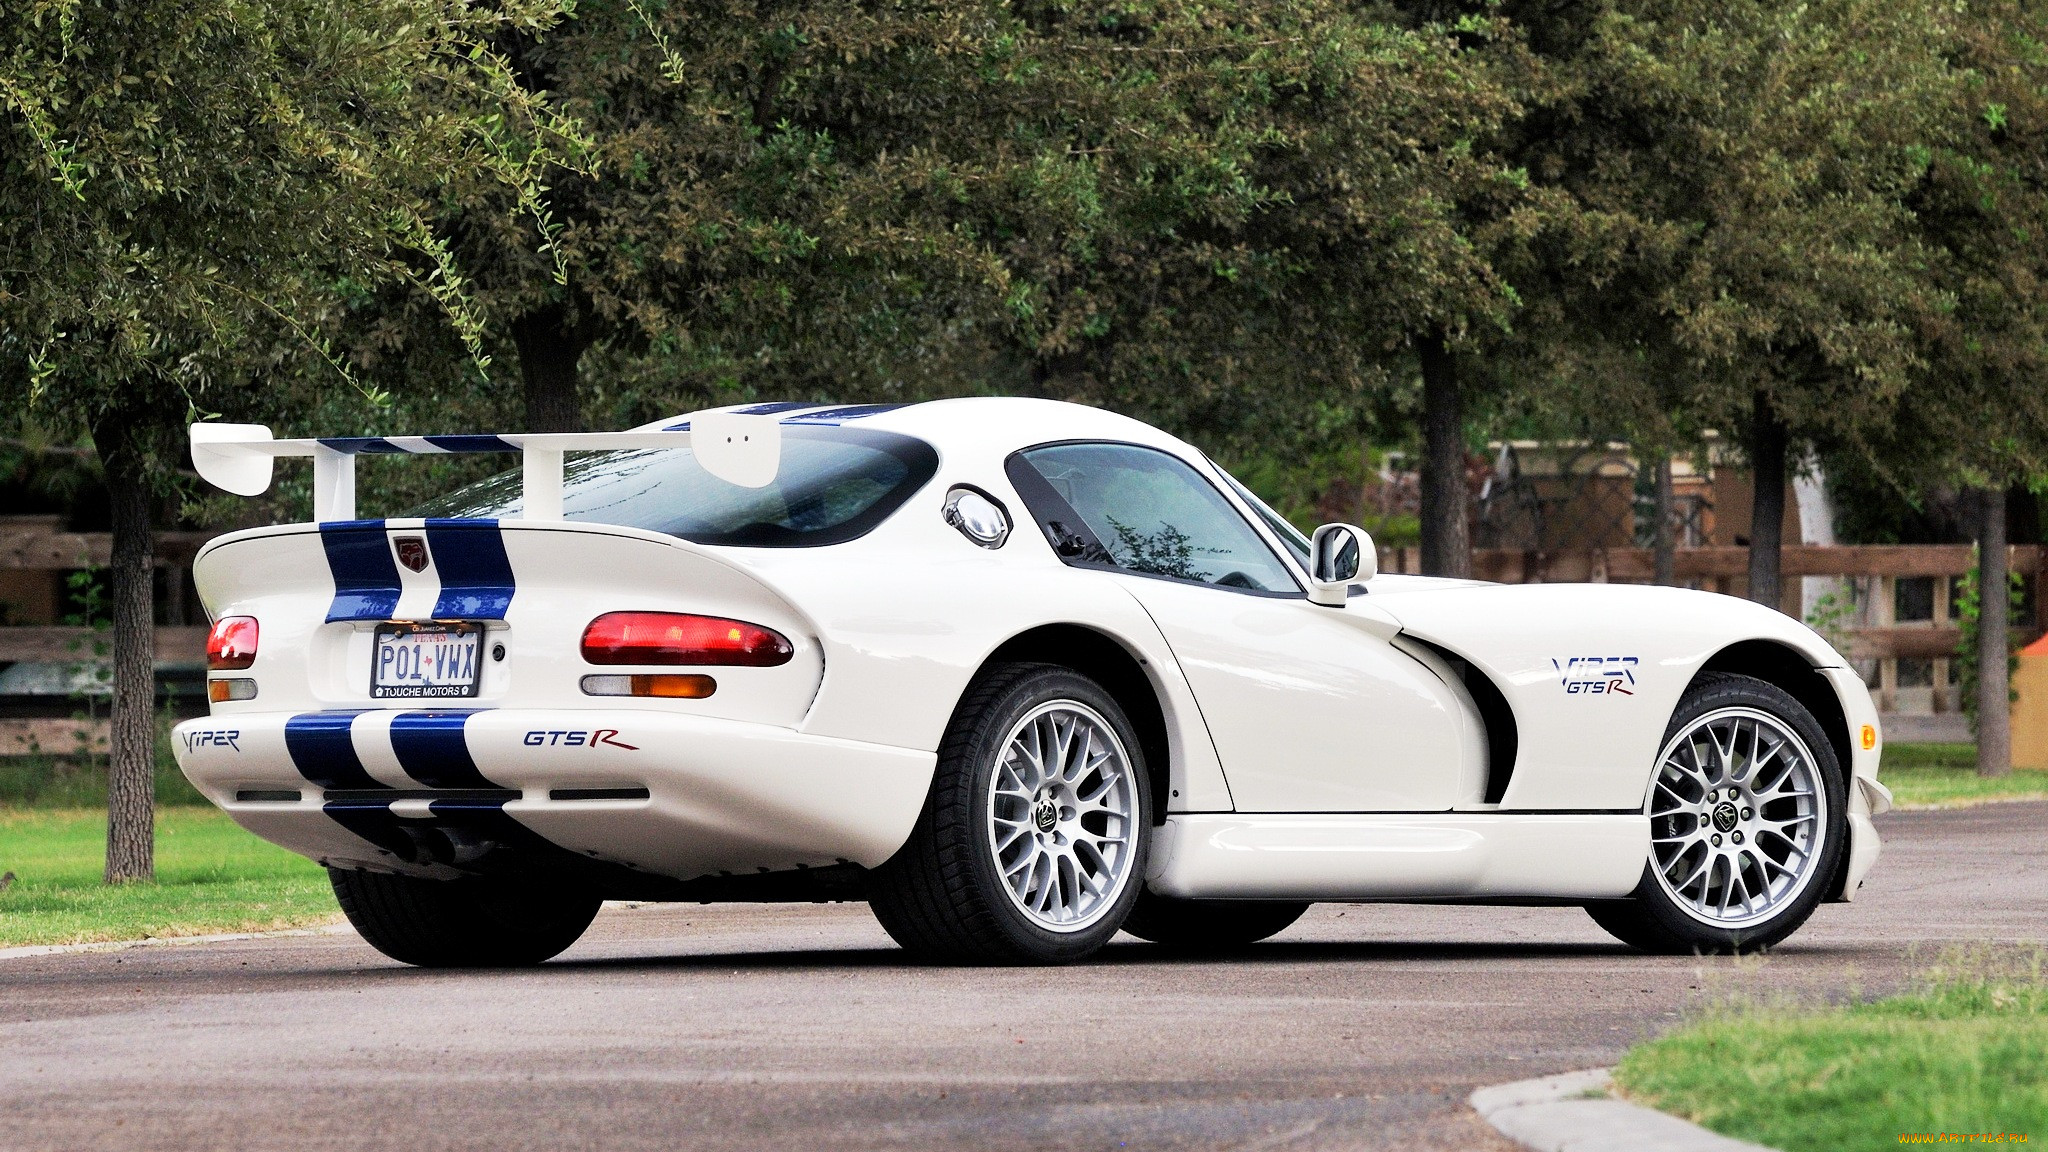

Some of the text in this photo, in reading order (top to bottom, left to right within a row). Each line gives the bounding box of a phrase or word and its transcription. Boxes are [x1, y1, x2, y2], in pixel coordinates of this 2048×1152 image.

[413, 633, 447, 643] TEXAS
[435, 644, 475, 680] VWX
[385, 686, 460, 697] TOUCHE MOTORS
